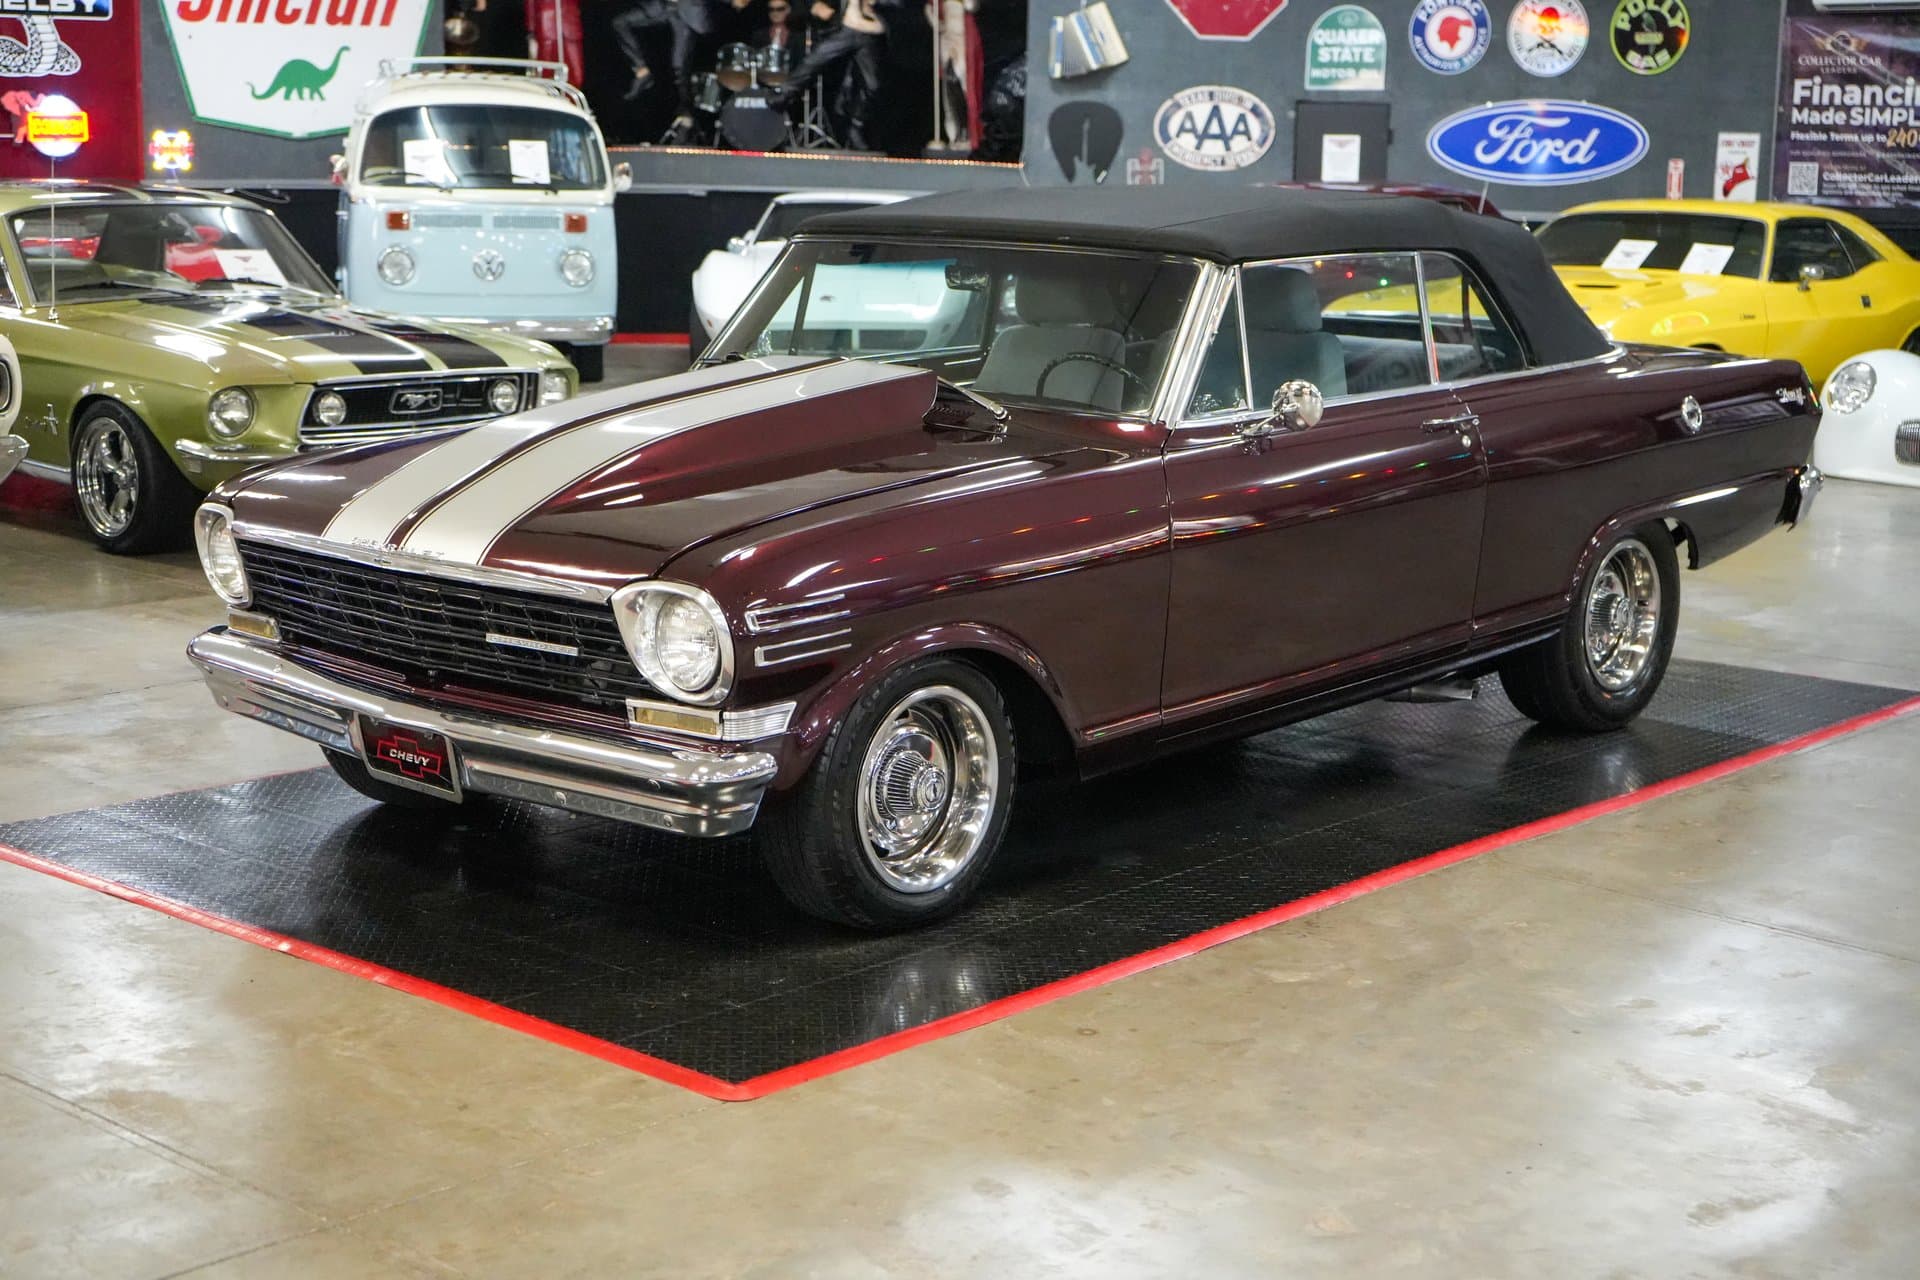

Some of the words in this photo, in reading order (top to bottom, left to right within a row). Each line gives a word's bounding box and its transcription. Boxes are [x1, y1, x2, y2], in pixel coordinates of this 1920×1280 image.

[0, 0, 97, 13] ELBY
[1313, 29, 1382, 46] QUAKER
[1318, 46, 1376, 63] STATE
[1859, 55, 1882, 66] CAR
[1791, 107, 1847, 125] Made
[1175, 104, 1252, 151] AAA
[1474, 114, 1600, 164] Ford
[1790, 131, 1828, 141] Flexible
[1830, 132, 1860, 143] Terms
[1860, 133, 1875, 145] up
[1876, 133, 1887, 143] to
[389, 748, 430, 766] CHEVY
